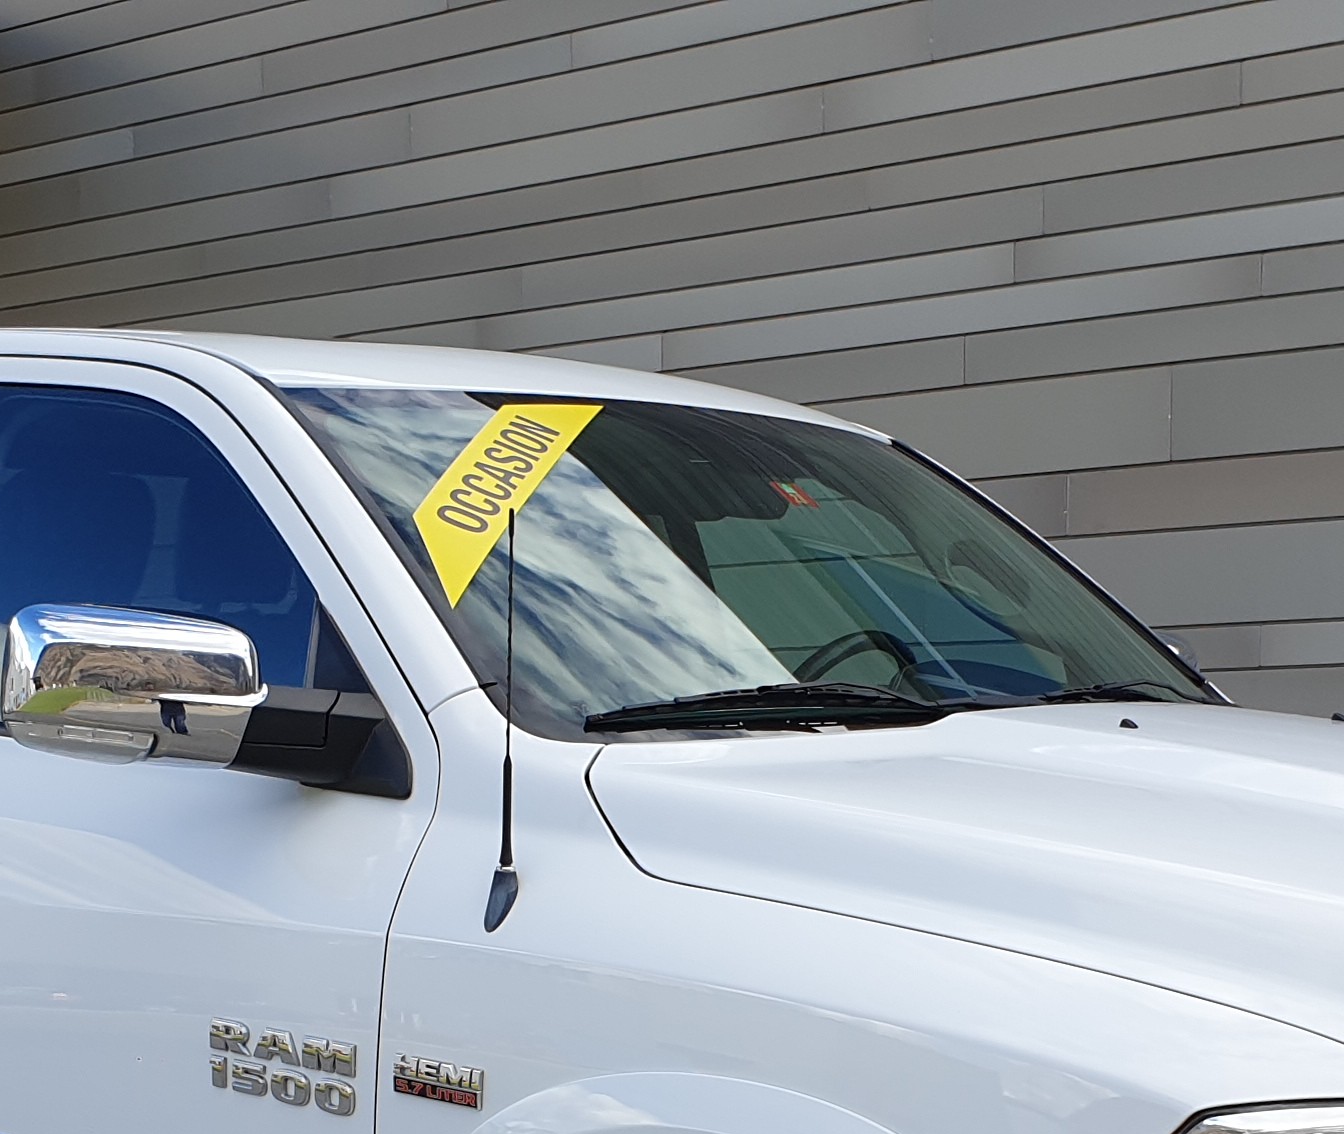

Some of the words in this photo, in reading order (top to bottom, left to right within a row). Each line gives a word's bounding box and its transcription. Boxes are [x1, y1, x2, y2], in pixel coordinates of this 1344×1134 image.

[436, 414, 561, 533] OCCASION
[209, 1016, 357, 1078] RAM
[393, 1052, 484, 1091] HEMI
[208, 1053, 356, 1117] 1500
[395, 1077, 424, 1095] 5.7
[425, 1083, 479, 1107] LITER
